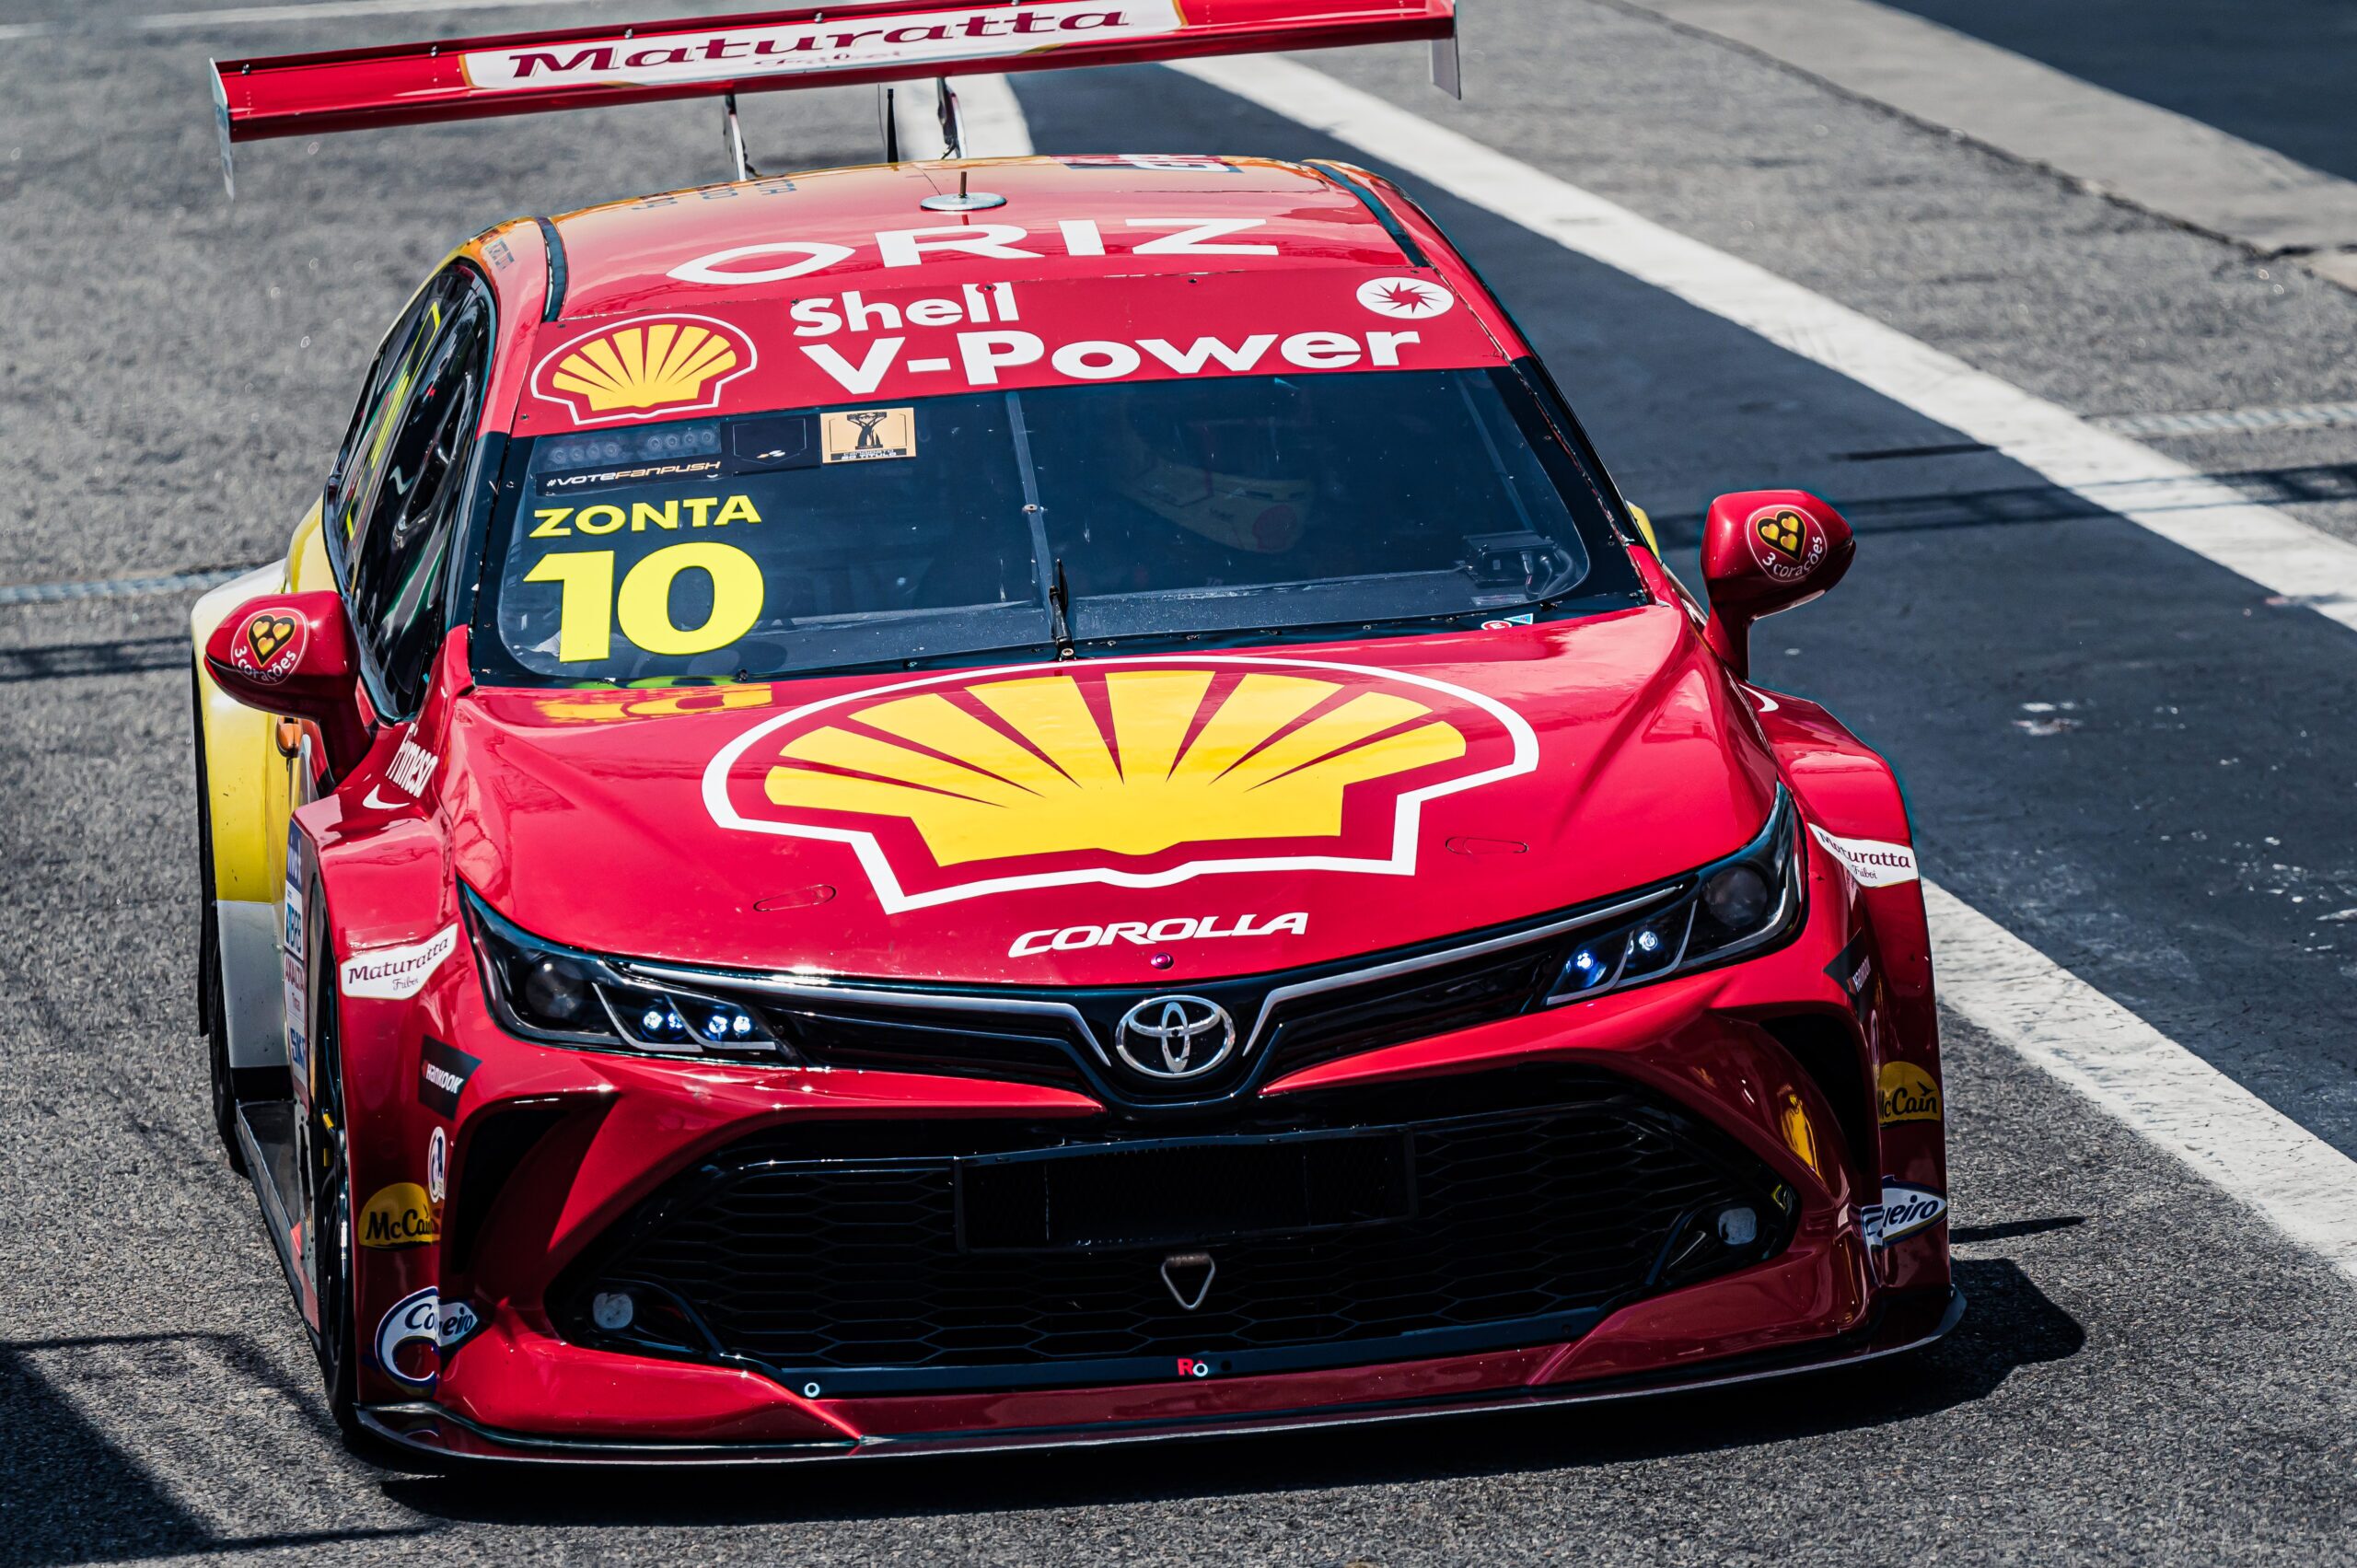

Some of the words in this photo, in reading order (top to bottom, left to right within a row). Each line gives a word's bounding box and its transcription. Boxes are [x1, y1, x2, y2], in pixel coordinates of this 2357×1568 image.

[509, 11, 1131, 78] Maturatta
[665, 217, 1279, 285] ORIZ
[789, 281, 1019, 337] Shell
[799, 330, 1421, 395] V-Power
[528, 494, 762, 538] ZONTA
[1762, 552, 1777, 566] 3
[1772, 536, 1823, 578] corações
[522, 541, 765, 663] 10
[234, 645, 248, 658] 3
[238, 649, 297, 683] corações
[1817, 830, 1911, 869] Maturatta
[1008, 912, 1309, 958] COROLLA
[348, 937, 448, 984] Maturatta
